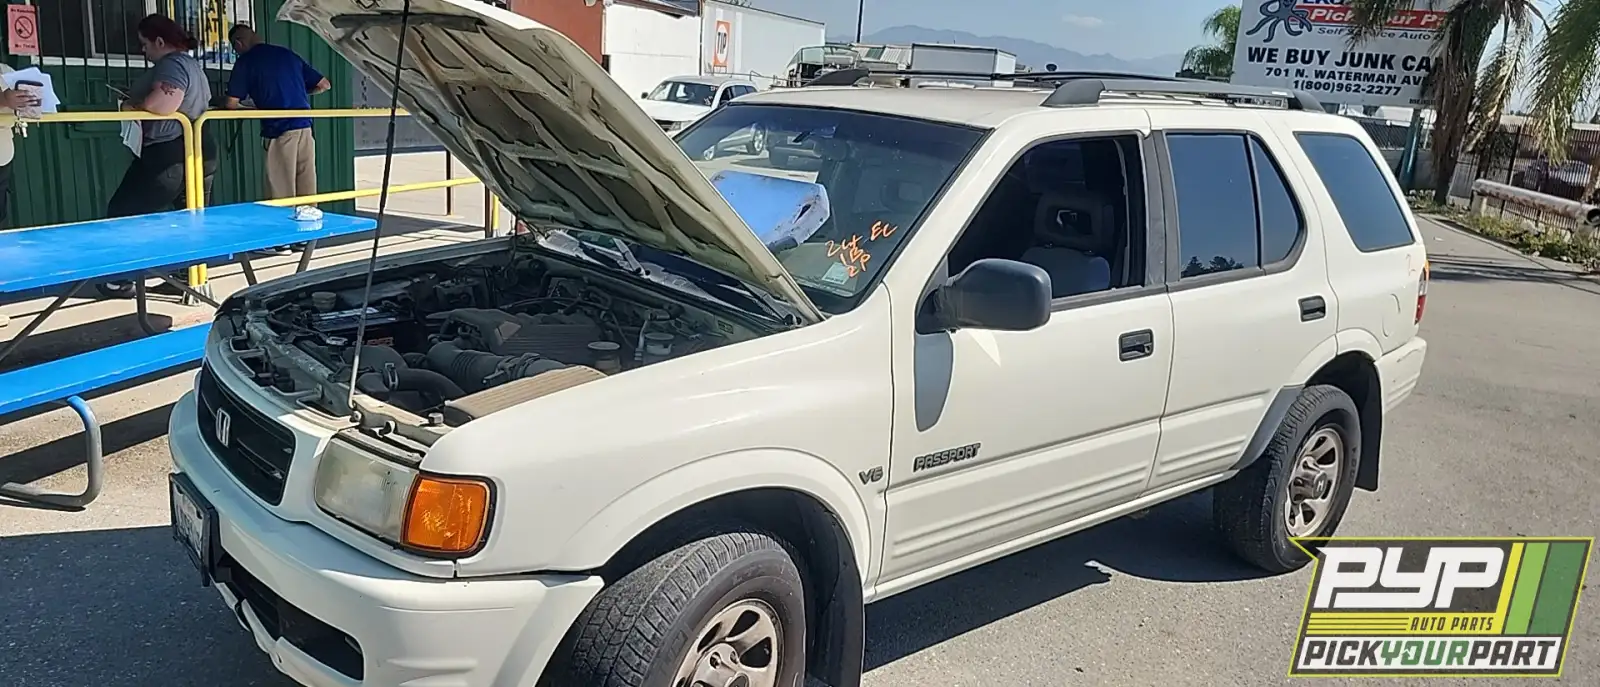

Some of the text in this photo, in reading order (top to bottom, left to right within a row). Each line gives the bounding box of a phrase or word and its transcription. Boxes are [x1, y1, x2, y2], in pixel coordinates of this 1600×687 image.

[717, 31, 727, 55] TIP
[1317, 27, 1343, 35] Self
[1398, 31, 1430, 41] Auto
[1247, 46, 1432, 73] WE BUY JUNK CA
[1265, 67, 1289, 77] 701
[1294, 68, 1309, 79] N.
[1314, 69, 1402, 84] WATERMAN
[1292, 79, 1402, 96] 1(800)962-2277
[913, 442, 981, 472] PASSPORT
[859, 465, 883, 485] V6
